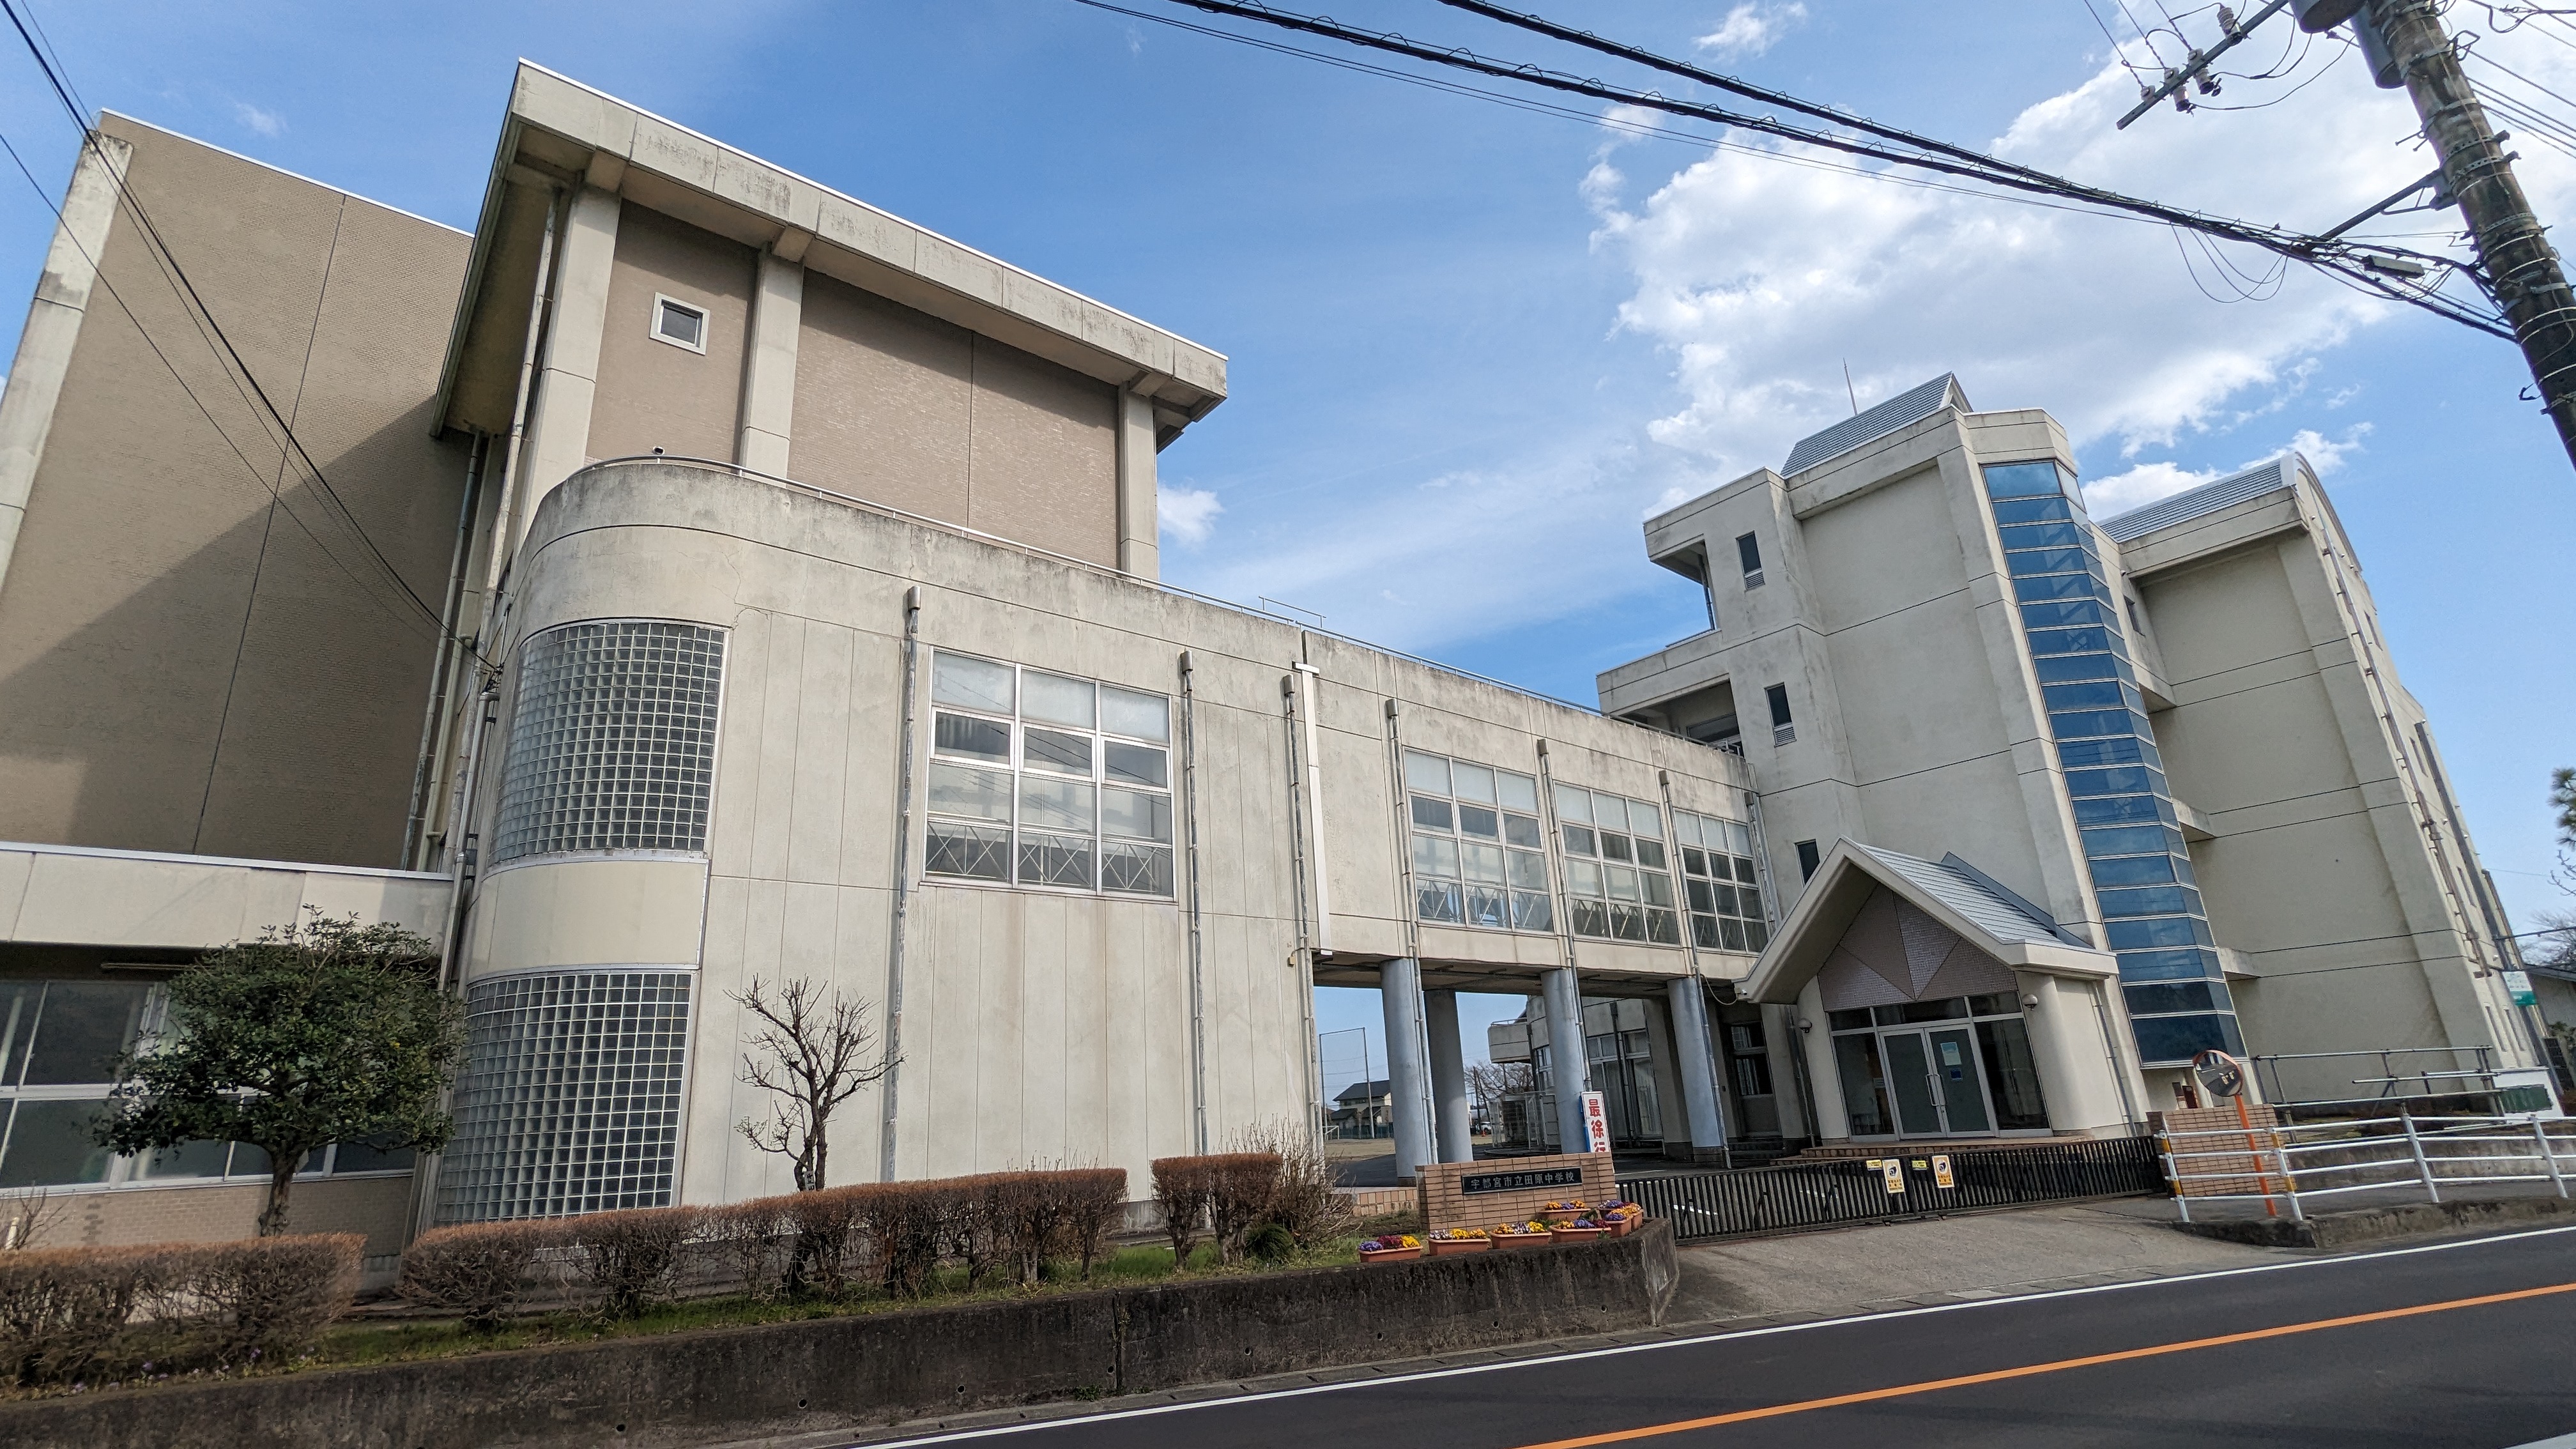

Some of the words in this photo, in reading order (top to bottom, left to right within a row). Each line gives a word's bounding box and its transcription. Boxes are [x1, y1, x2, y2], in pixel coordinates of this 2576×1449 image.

[1471, 1171, 1574, 1189] 宇都宮市立田原中学校
